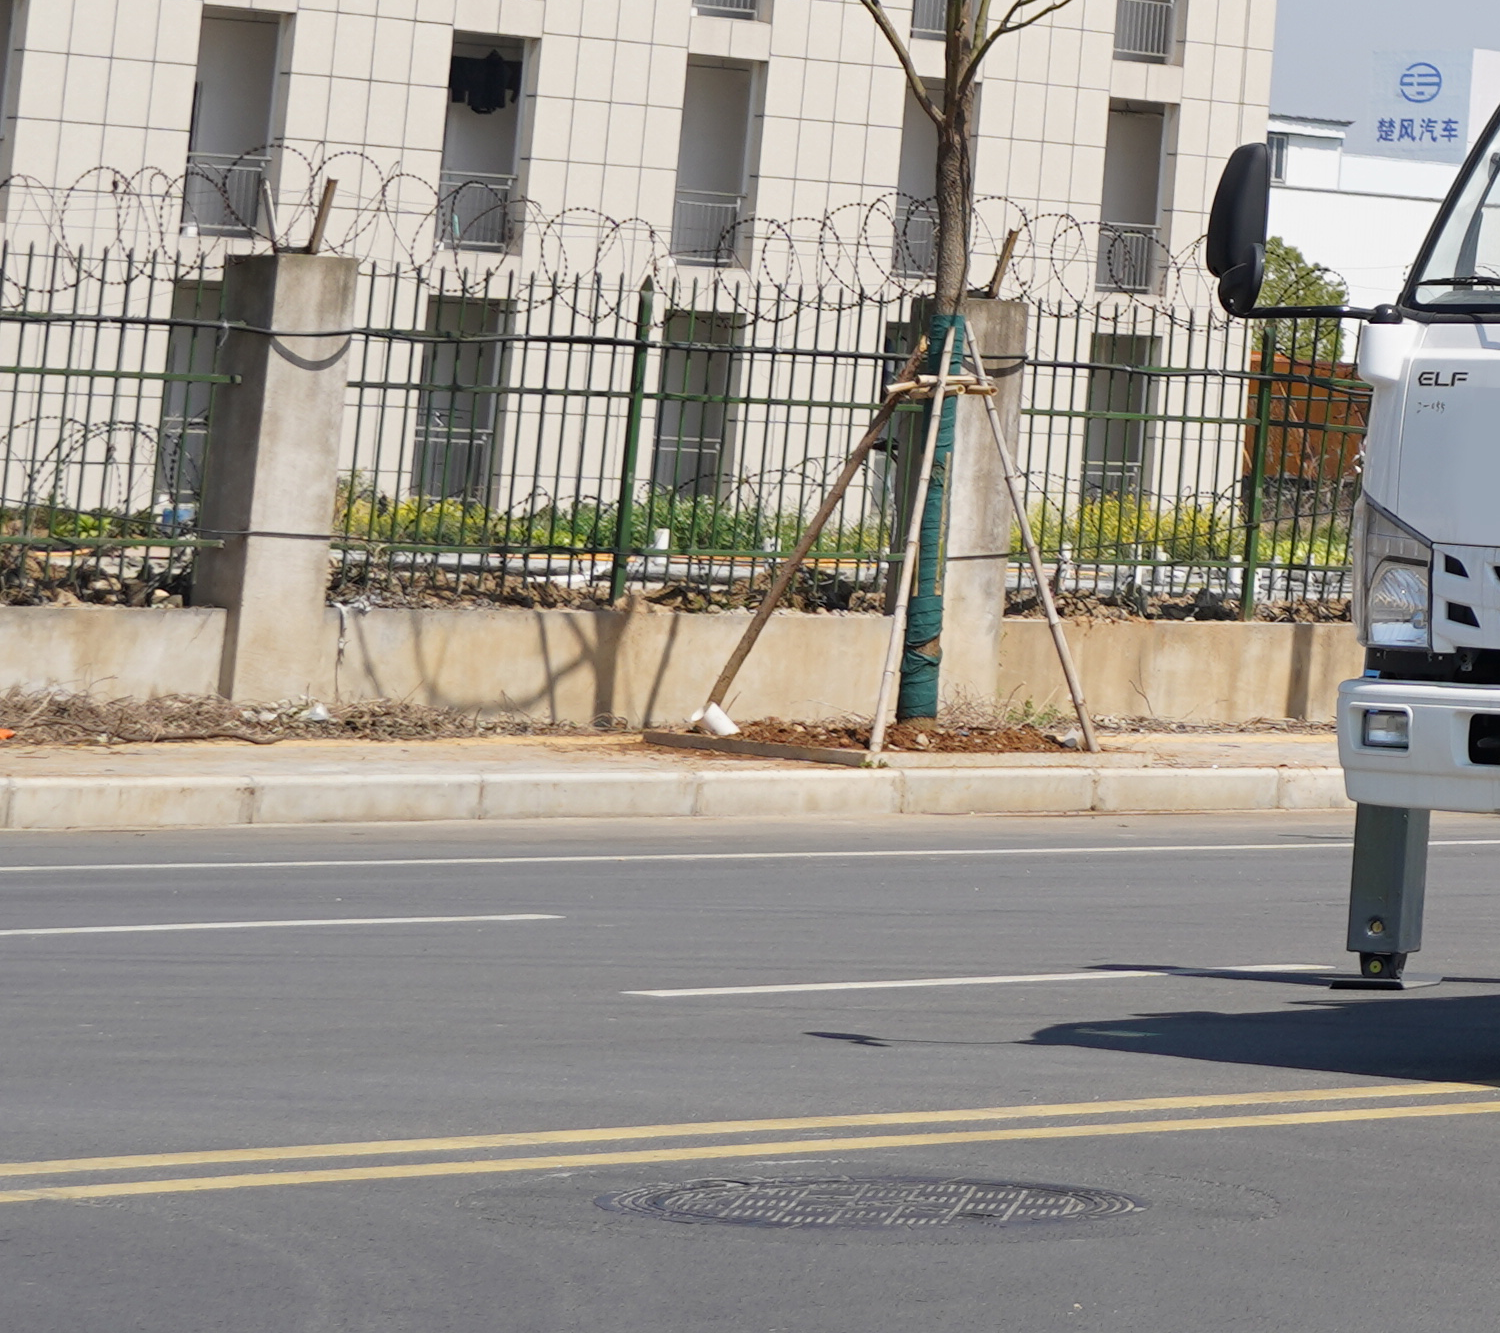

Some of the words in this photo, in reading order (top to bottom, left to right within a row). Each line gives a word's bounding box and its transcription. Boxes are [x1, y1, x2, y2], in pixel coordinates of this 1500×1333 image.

[1376, 117, 1459, 143] 楚风汽车
[1418, 371, 1469, 387] ELF
